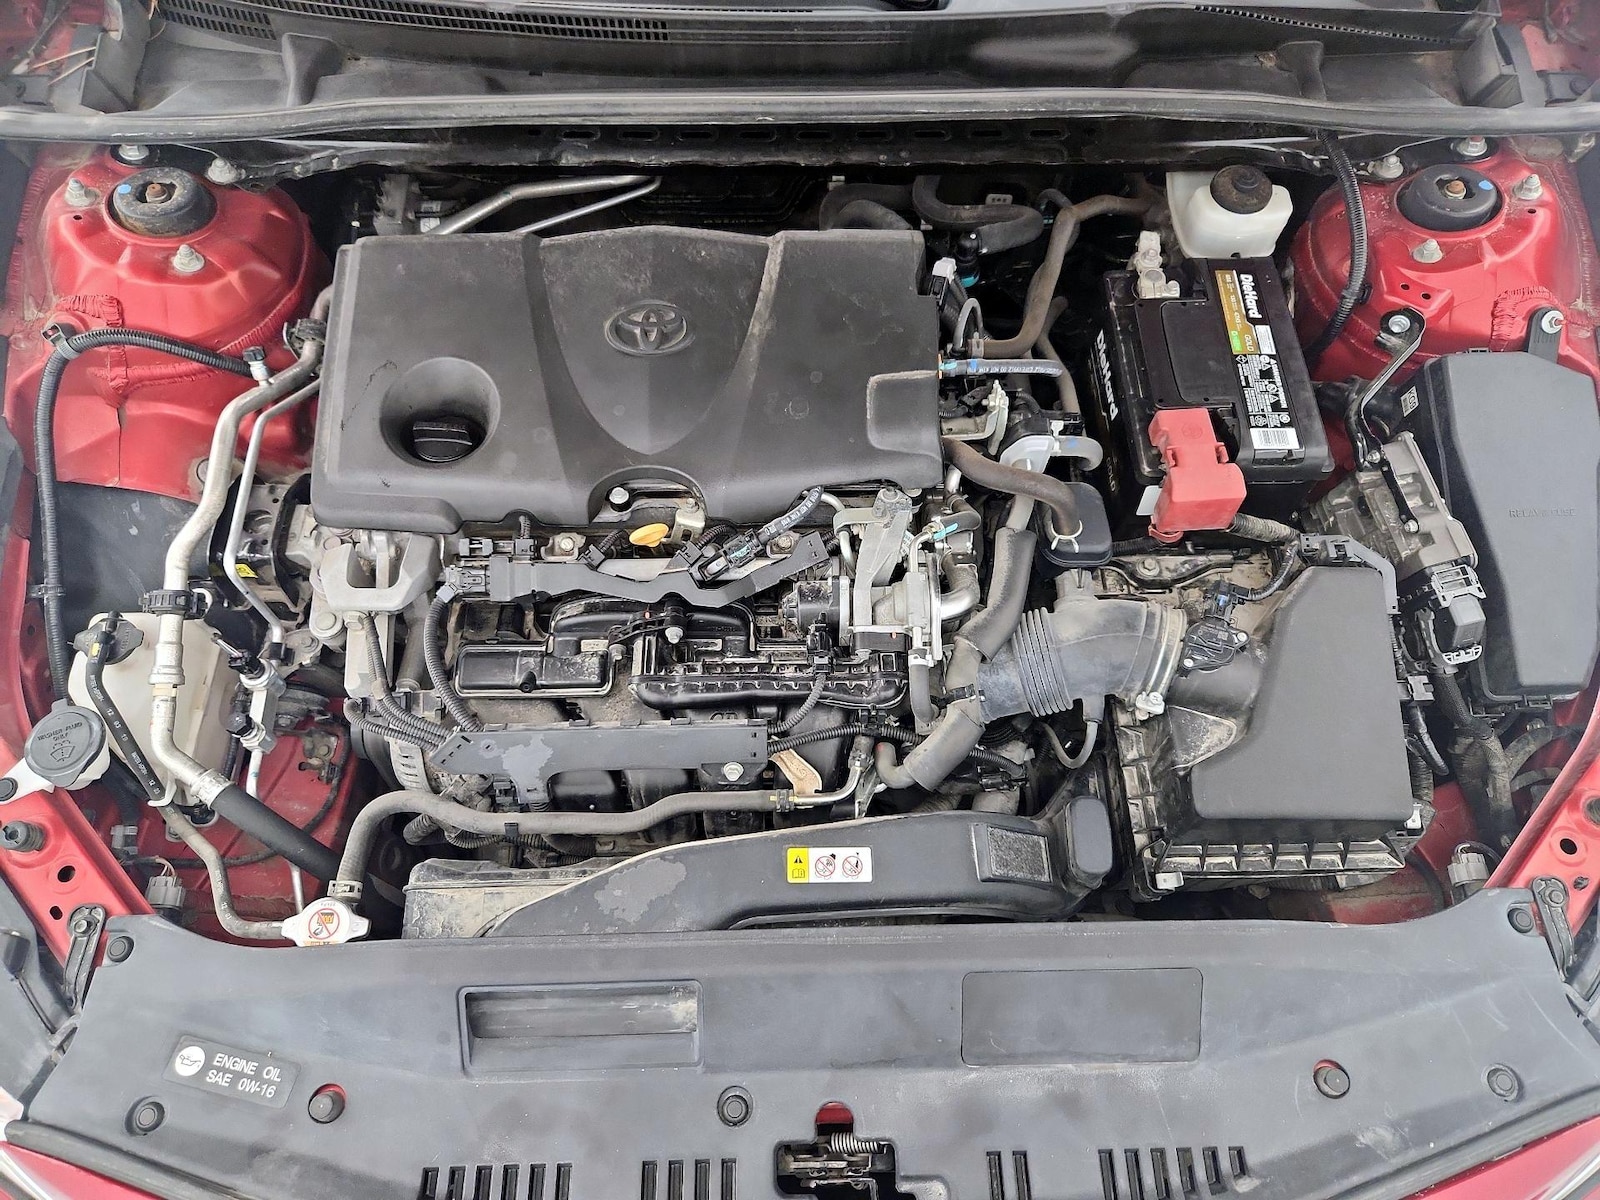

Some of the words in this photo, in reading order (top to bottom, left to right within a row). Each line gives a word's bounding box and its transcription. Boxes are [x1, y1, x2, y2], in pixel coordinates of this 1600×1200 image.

[1240, 273, 1263, 319] DieHard
[1244, 334, 1255, 352] GOLD
[1096, 329, 1119, 422] DieHard
[212, 1052, 259, 1075] ENGINE
[263, 1066, 282, 1082] OIL
[206, 1069, 233, 1087] SAE
[237, 1077, 277, 1098] 0W-16
